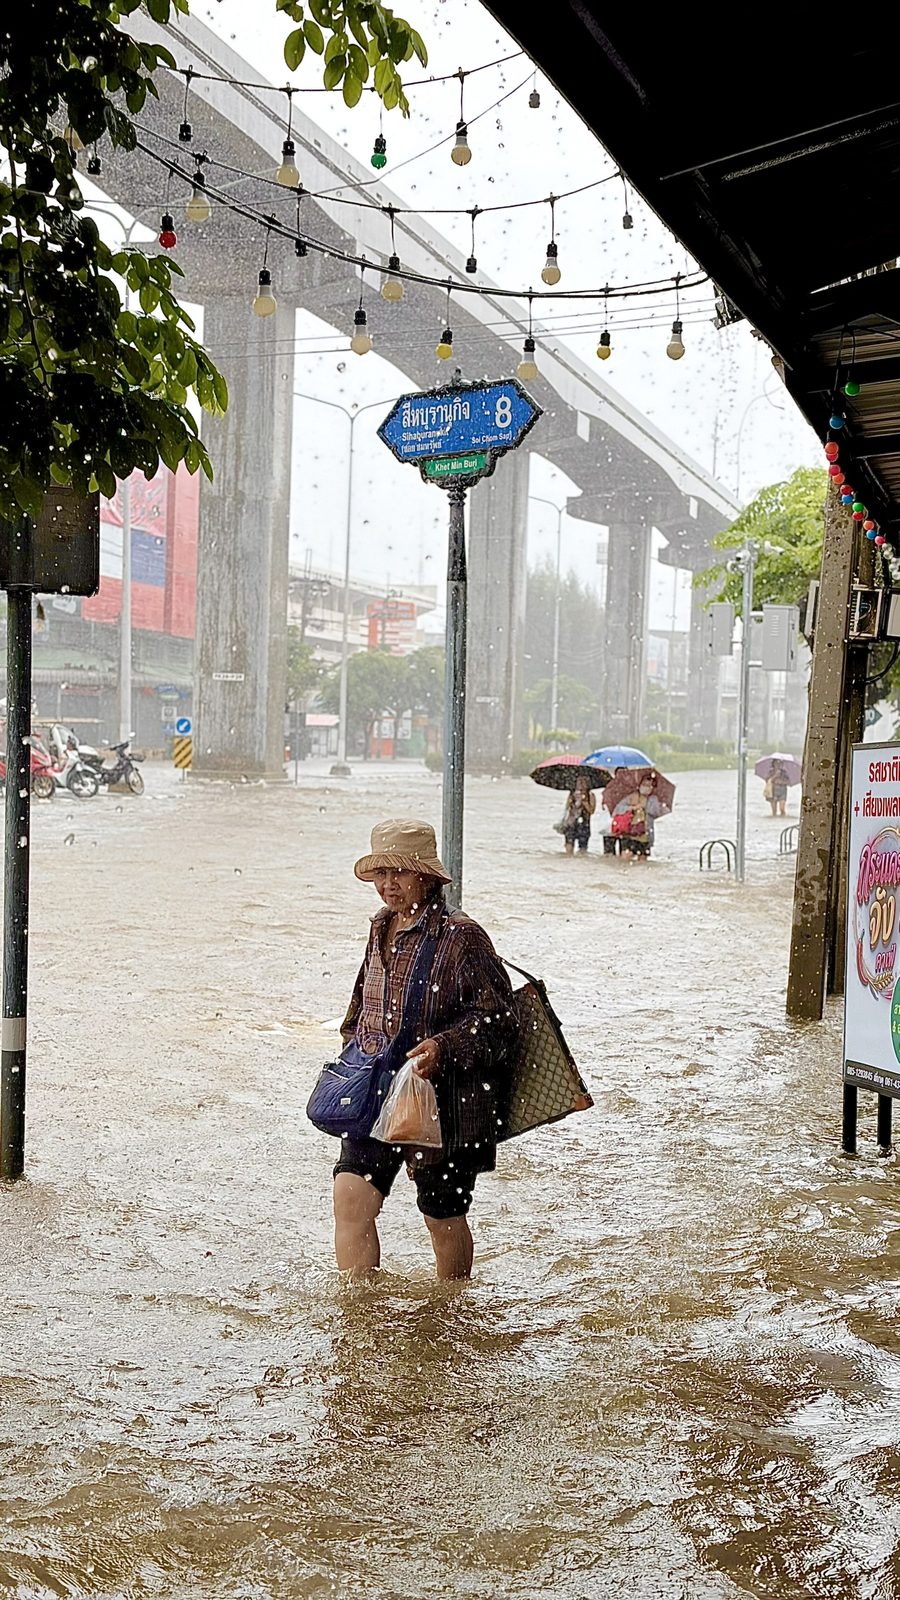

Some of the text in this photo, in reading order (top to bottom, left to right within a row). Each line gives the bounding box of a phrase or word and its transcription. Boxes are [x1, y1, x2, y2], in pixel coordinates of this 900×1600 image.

[402, 396, 512, 430] สีหบุรานุกิจ 8
[472, 436, 481, 444] Soi
[435, 459, 478, 472] Khet Min Buri
[869, 755, 900, 782] รสชาติ
[863, 790, 900, 817] เสียงเพล
